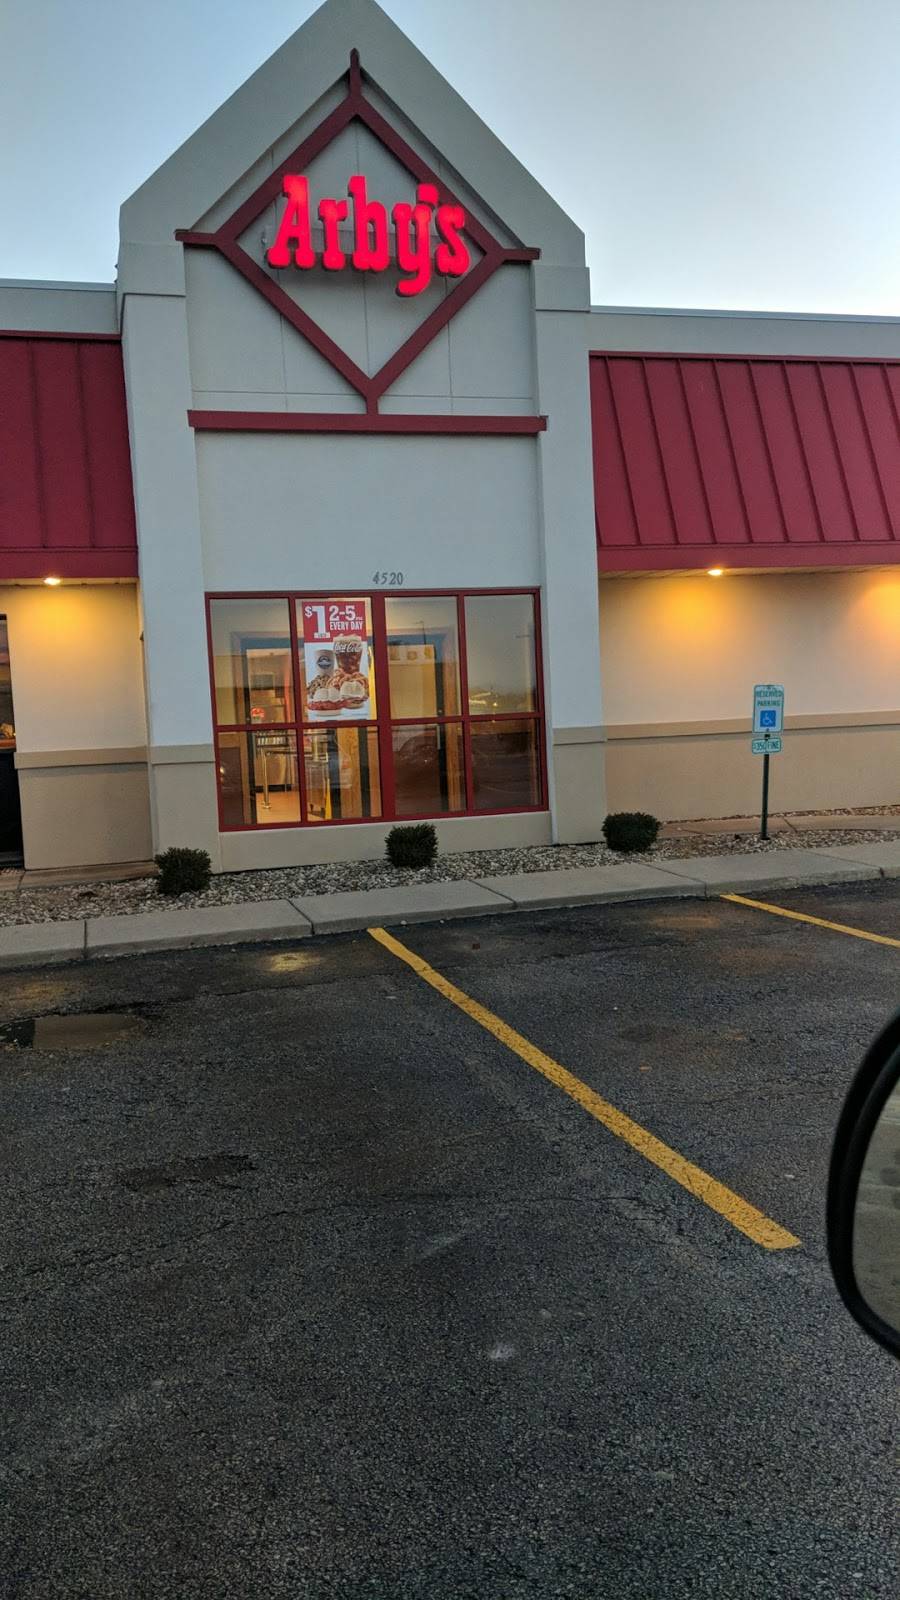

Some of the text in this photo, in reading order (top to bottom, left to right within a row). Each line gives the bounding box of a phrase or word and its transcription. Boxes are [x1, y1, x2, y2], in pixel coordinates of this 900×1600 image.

[267, 174, 471, 296] Arby's
[372, 571, 403, 586] 4520
[329, 605, 356, 621] 2-5
[329, 621, 363, 631] EVERY DAY
[755, 690, 783, 698] RESERVED
[767, 739, 780, 750] FINE
